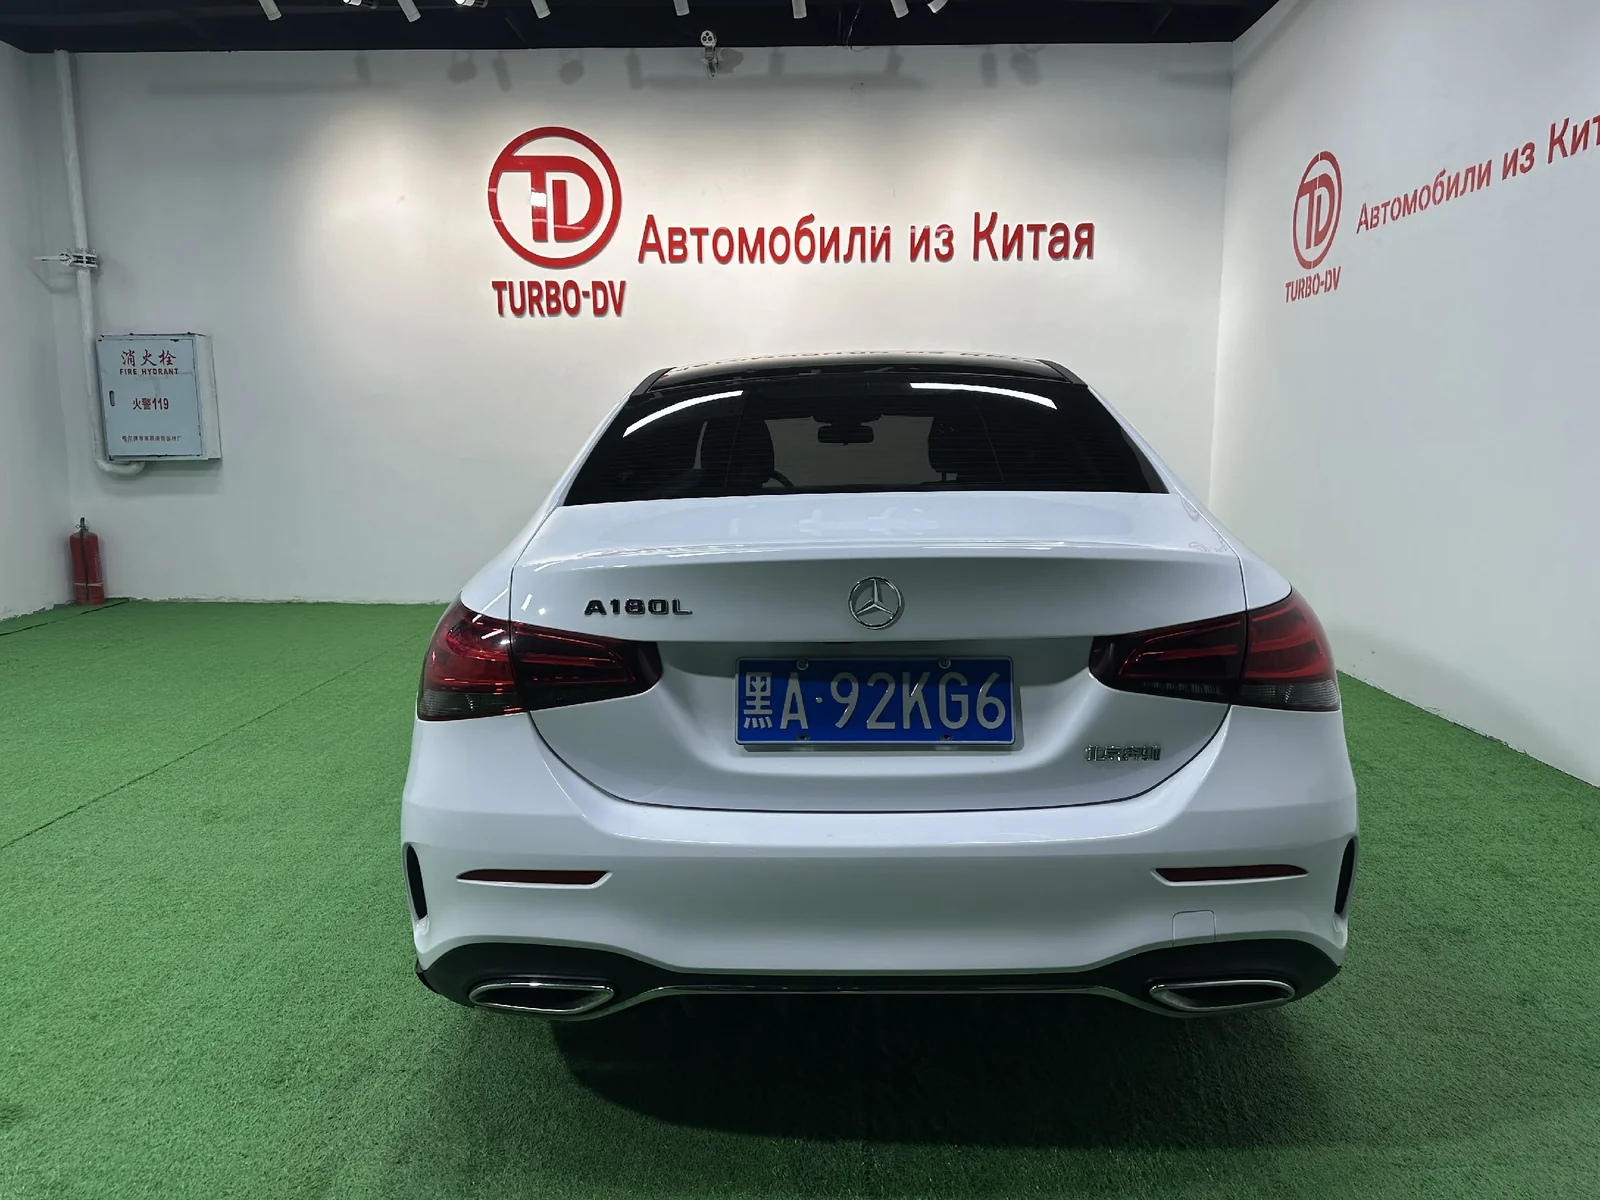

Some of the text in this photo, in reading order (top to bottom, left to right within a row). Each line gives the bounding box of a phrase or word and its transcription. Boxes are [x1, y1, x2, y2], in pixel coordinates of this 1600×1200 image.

[1356, 159, 1493, 235] Автомобили
[1502, 142, 1536, 181] из
[637, 211, 1096, 265] Автомобили из Китая
[491, 279, 627, 317] TURBO-DV
[1285, 266, 1342, 303] TURBO-DV
[119, 368, 179, 376] FIRE HYDRANT
[120, 348, 176, 367] 消火栓
[584, 598, 693, 617] A180L
